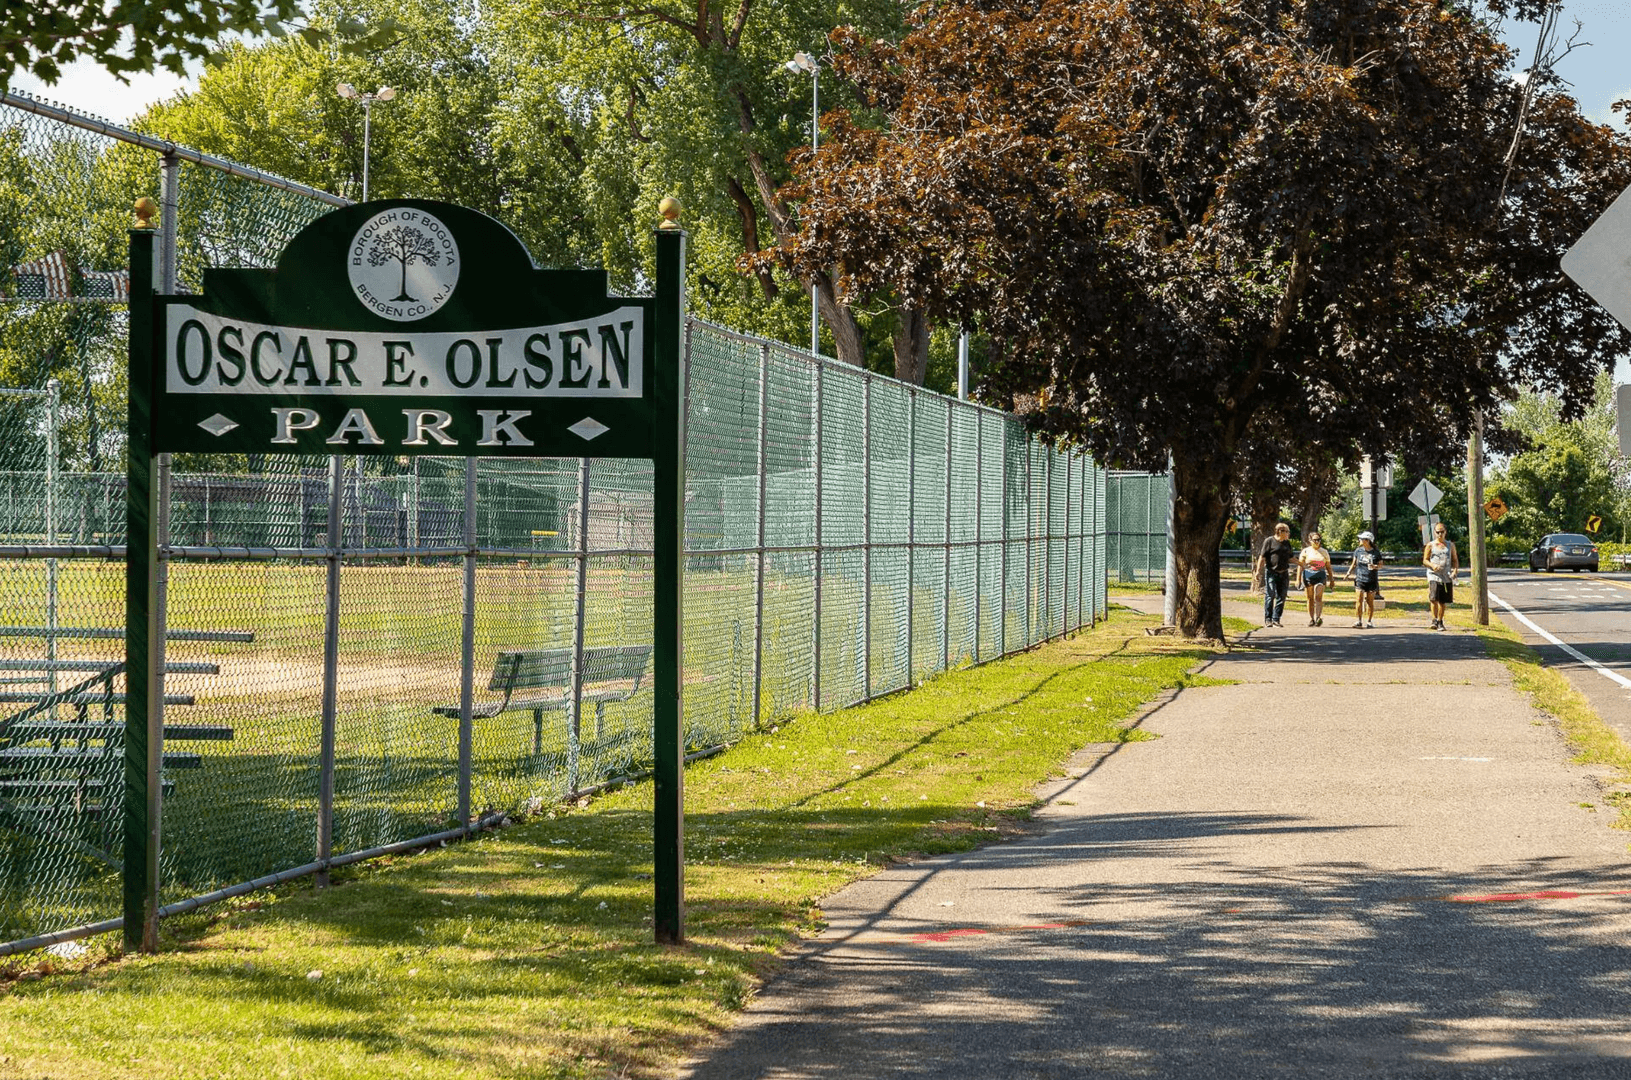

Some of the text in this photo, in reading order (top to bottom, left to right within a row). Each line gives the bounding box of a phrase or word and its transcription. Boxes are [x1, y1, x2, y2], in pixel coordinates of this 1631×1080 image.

[353, 211, 455, 266] BOROUGH OF BOGOTA
[357, 283, 403, 317] BERGEN
[433, 283, 453, 304] N.J.
[176, 318, 634, 391] OSCAR E. OLSEN
[270, 407, 535, 447] PARK
